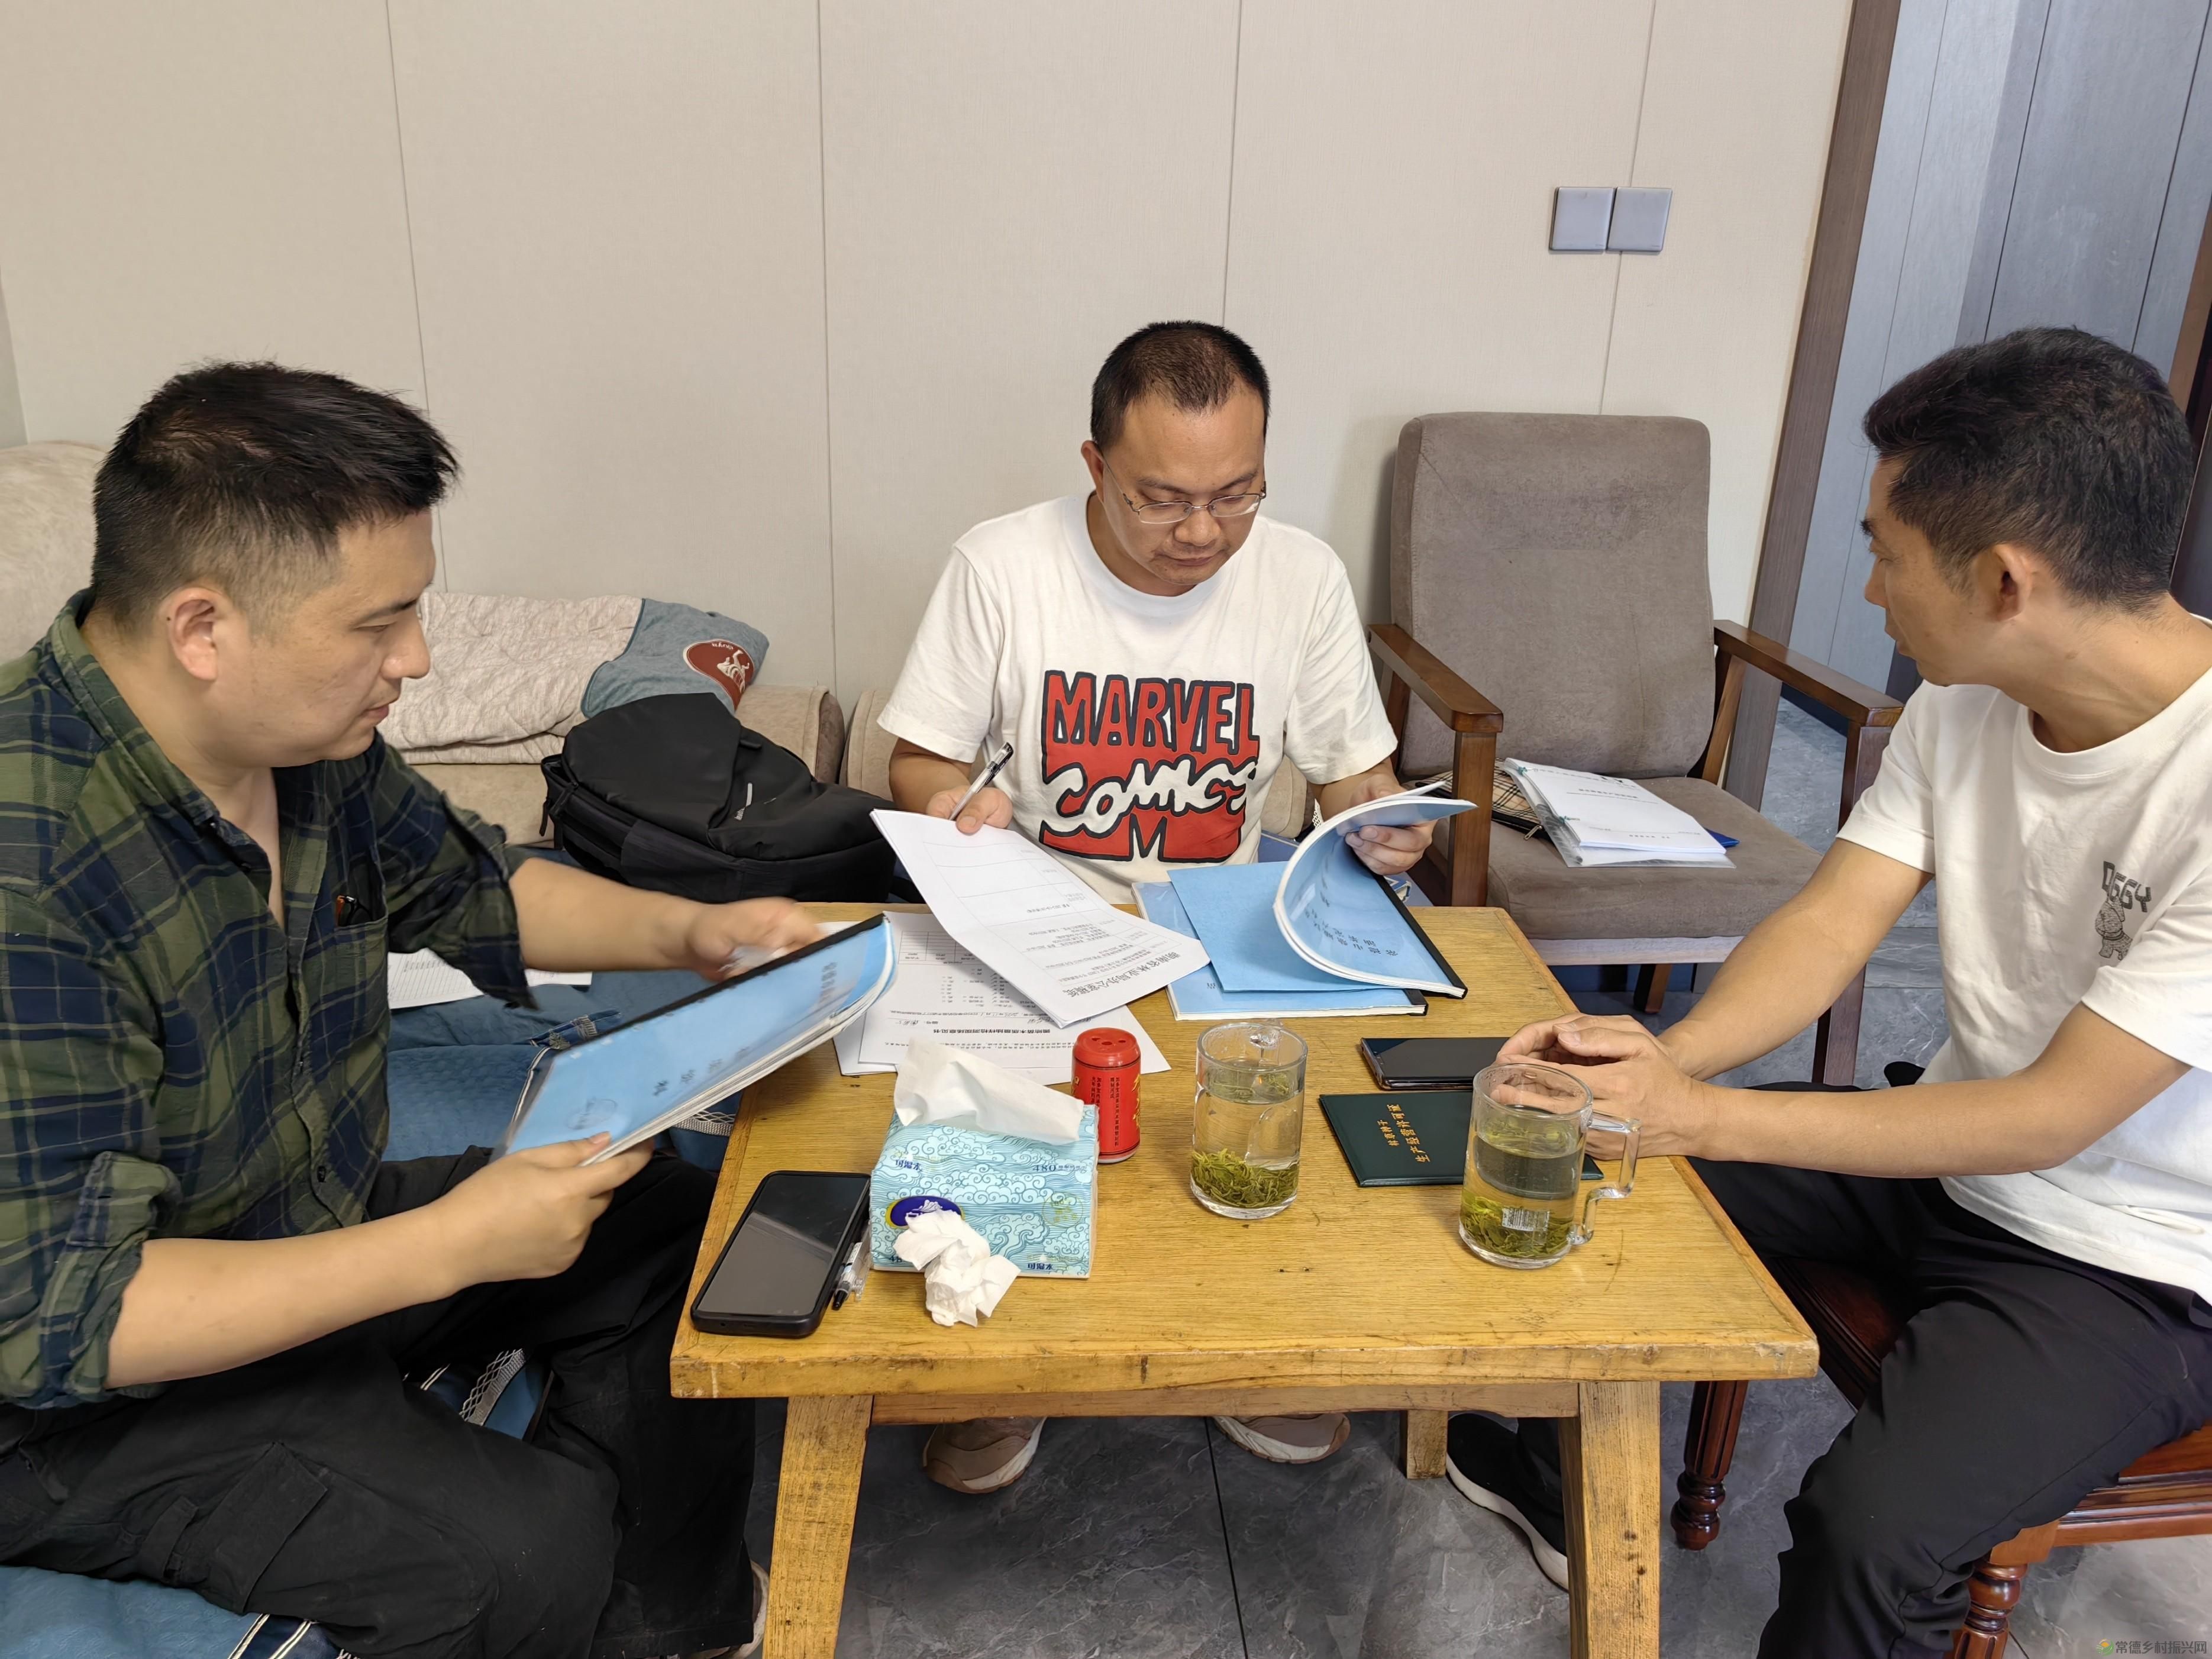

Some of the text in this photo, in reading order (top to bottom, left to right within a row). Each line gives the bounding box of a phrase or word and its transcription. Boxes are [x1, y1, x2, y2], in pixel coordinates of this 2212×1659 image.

[1042, 670, 1260, 755] MARVEL
[1063, 951, 1181, 998] 湖南省林业局办公室稿纸
[1387, 1103, 1430, 1163] 生产经营许可证
